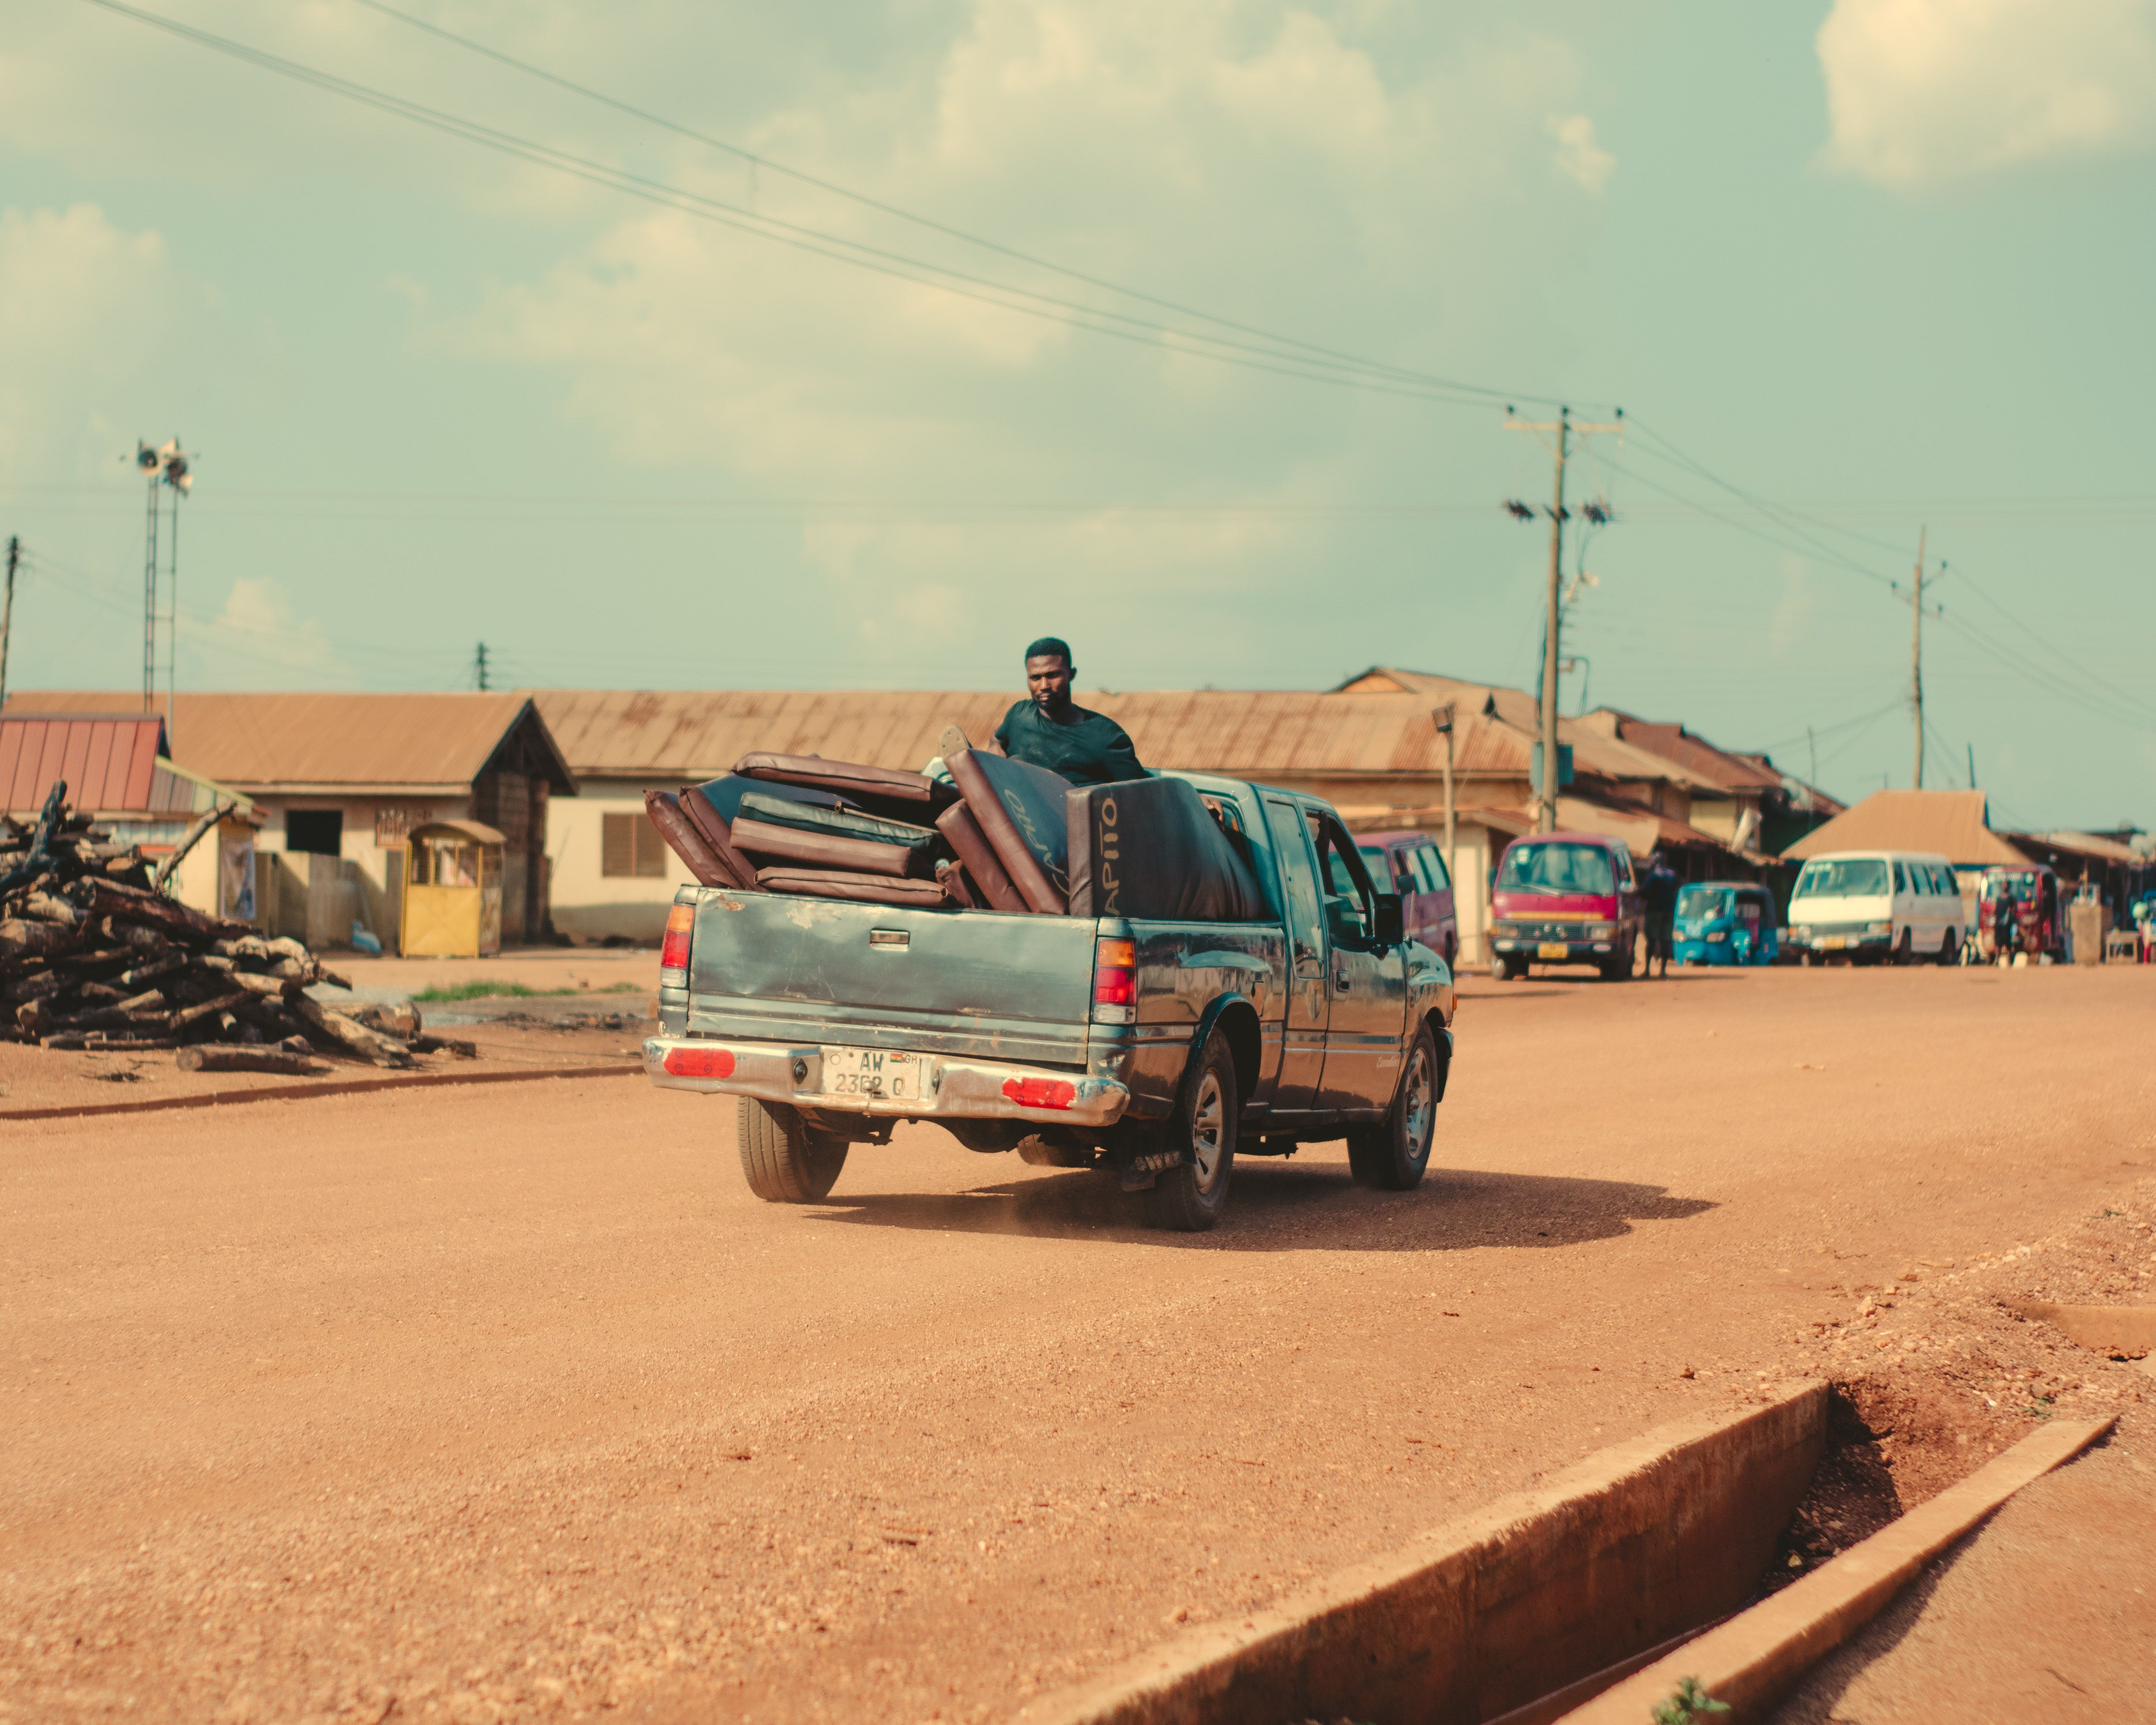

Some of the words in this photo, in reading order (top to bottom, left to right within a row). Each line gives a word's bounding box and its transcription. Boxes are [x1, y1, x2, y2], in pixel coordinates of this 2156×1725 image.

[1099, 797, 1120, 916] APITO
[860, 1052, 884, 1072] AW
[905, 1054, 917, 1064] GH
[892, 1077, 905, 1096] Q
